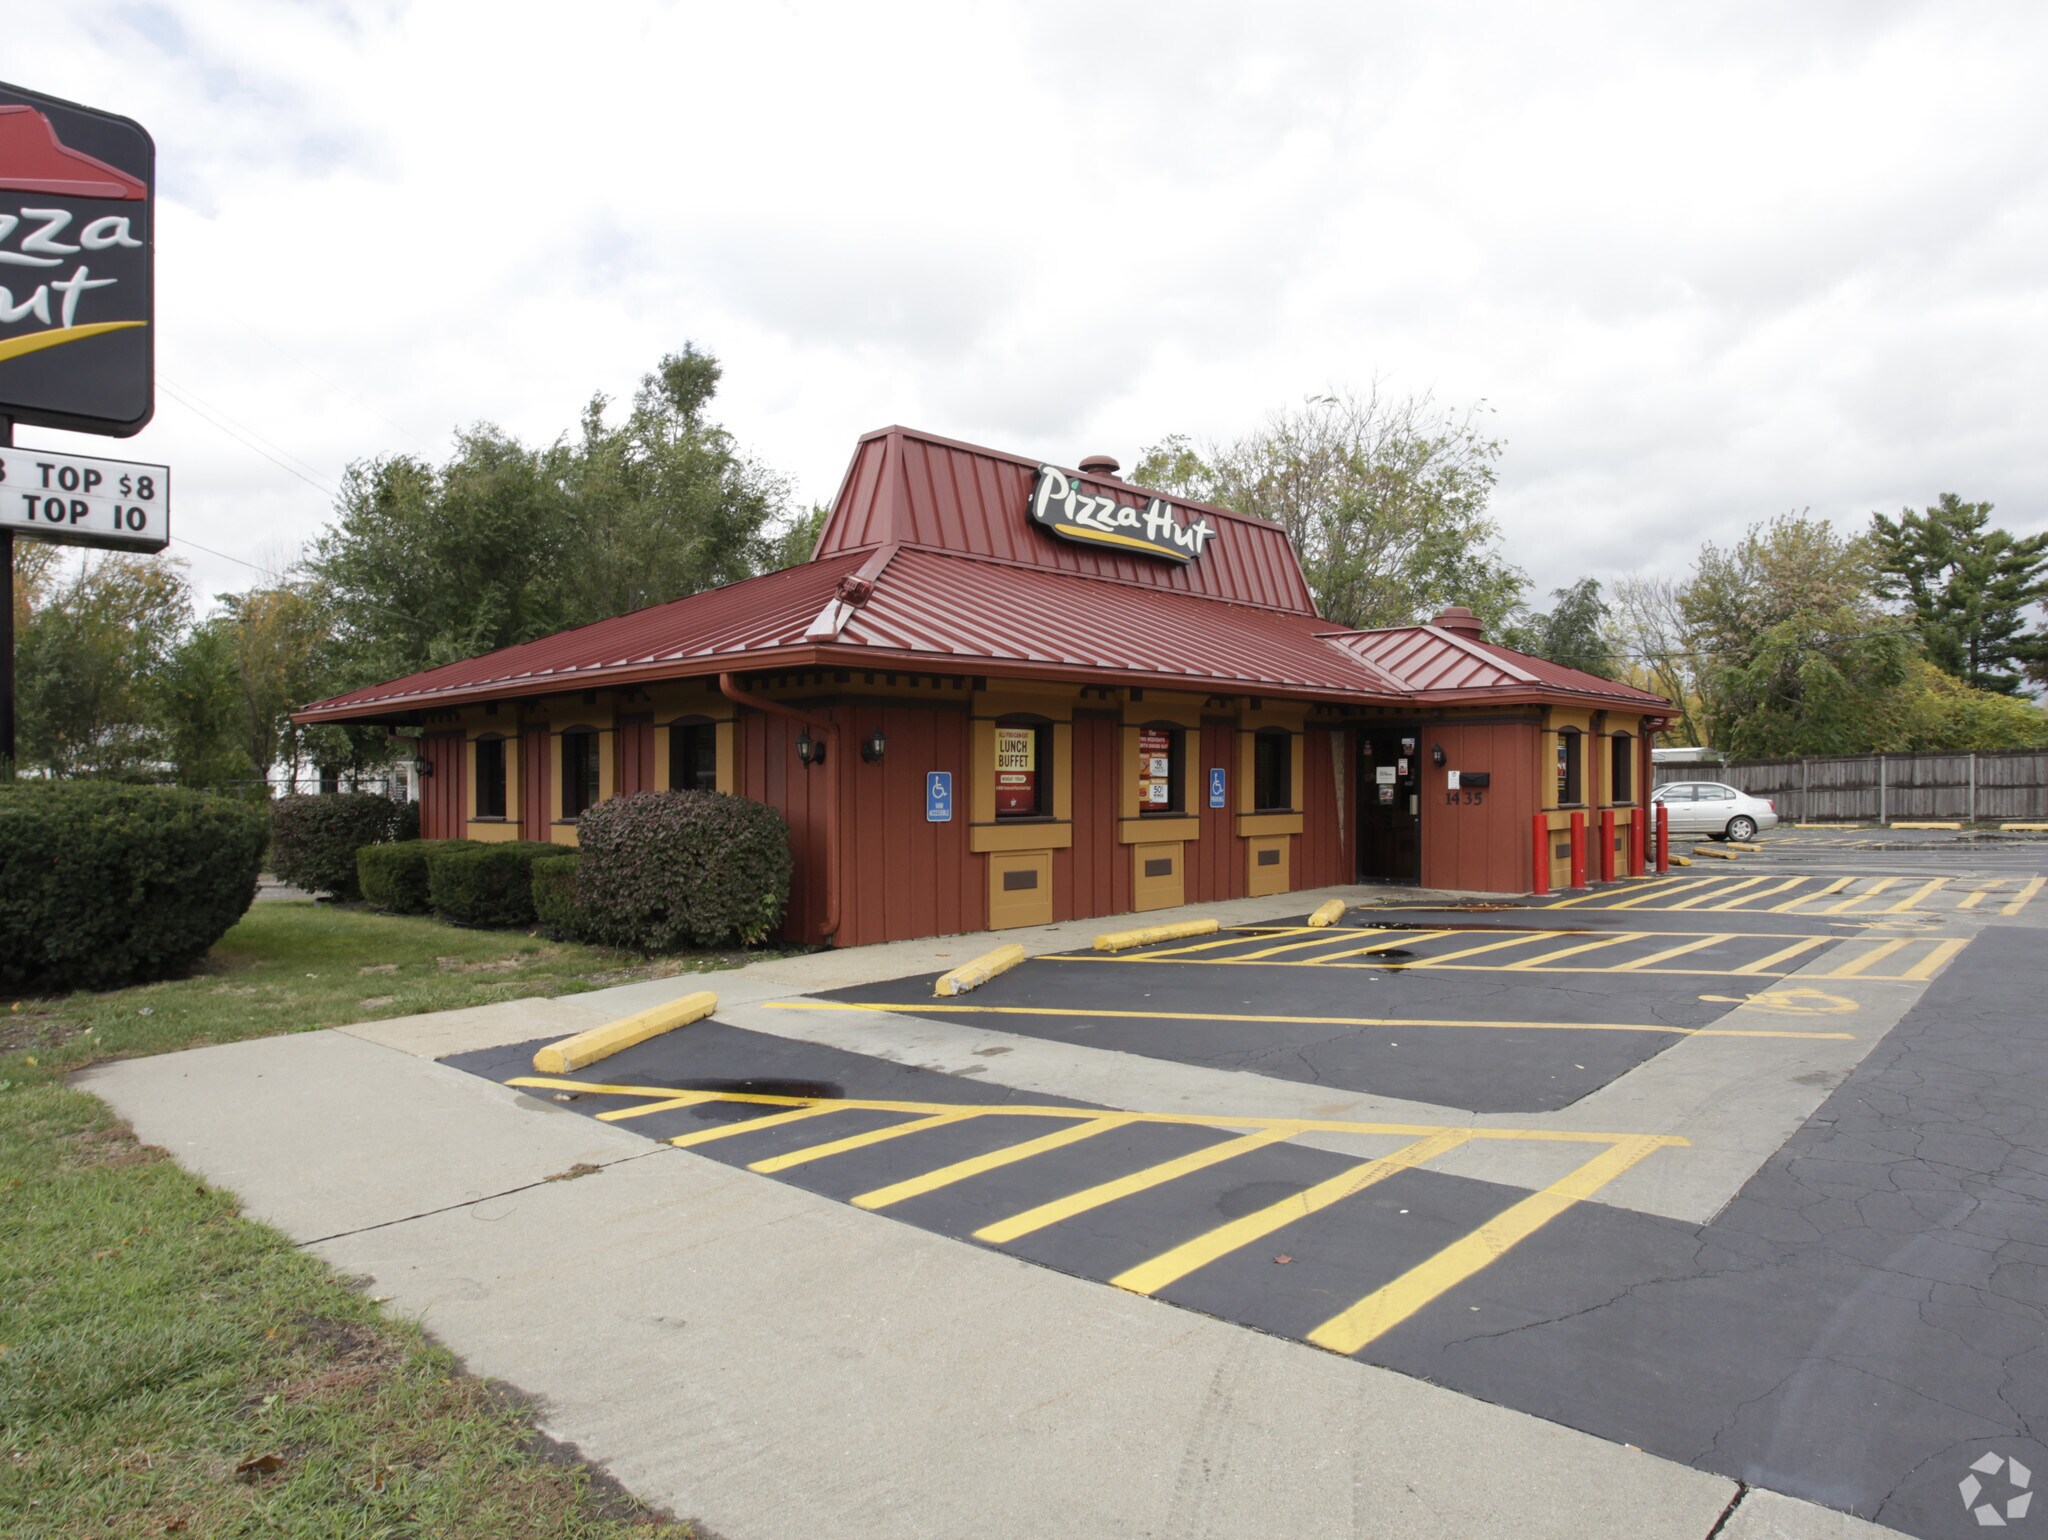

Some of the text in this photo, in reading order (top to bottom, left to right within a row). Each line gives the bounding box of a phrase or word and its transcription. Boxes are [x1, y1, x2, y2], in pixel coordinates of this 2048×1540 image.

[36, 462, 102, 493] TOP
[119, 473, 155, 500] $8
[22, 494, 147, 531] TOP 10
[1037, 466, 1216, 553] Pizza Hut
[998, 754, 1029, 768] BUFFET
[1000, 740, 1028, 753] LUNCH
